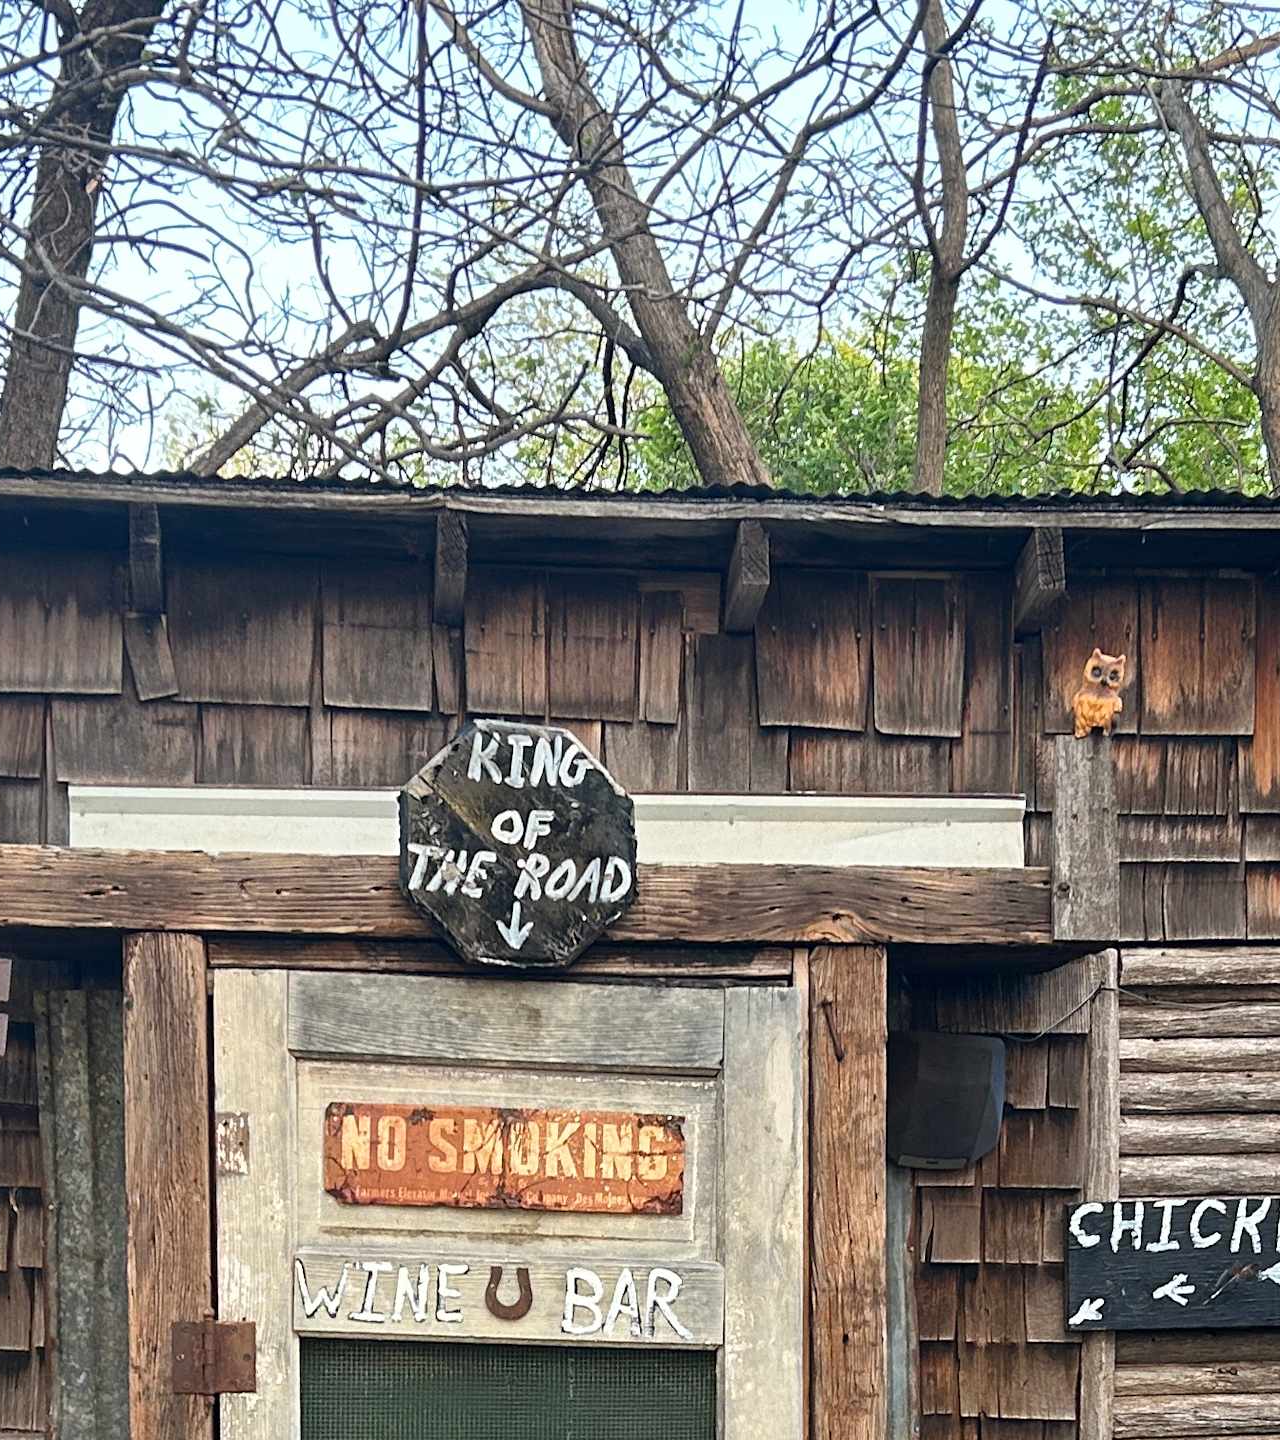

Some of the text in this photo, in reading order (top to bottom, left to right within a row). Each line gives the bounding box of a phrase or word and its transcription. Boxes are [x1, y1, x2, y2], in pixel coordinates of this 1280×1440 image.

[467, 732, 594, 788] KING
[491, 809, 555, 850] OF
[407, 843, 632, 903] THE ROAD
[341, 1115, 668, 1181] NO SMOKING
[294, 1258, 694, 1340] WINE BAR
